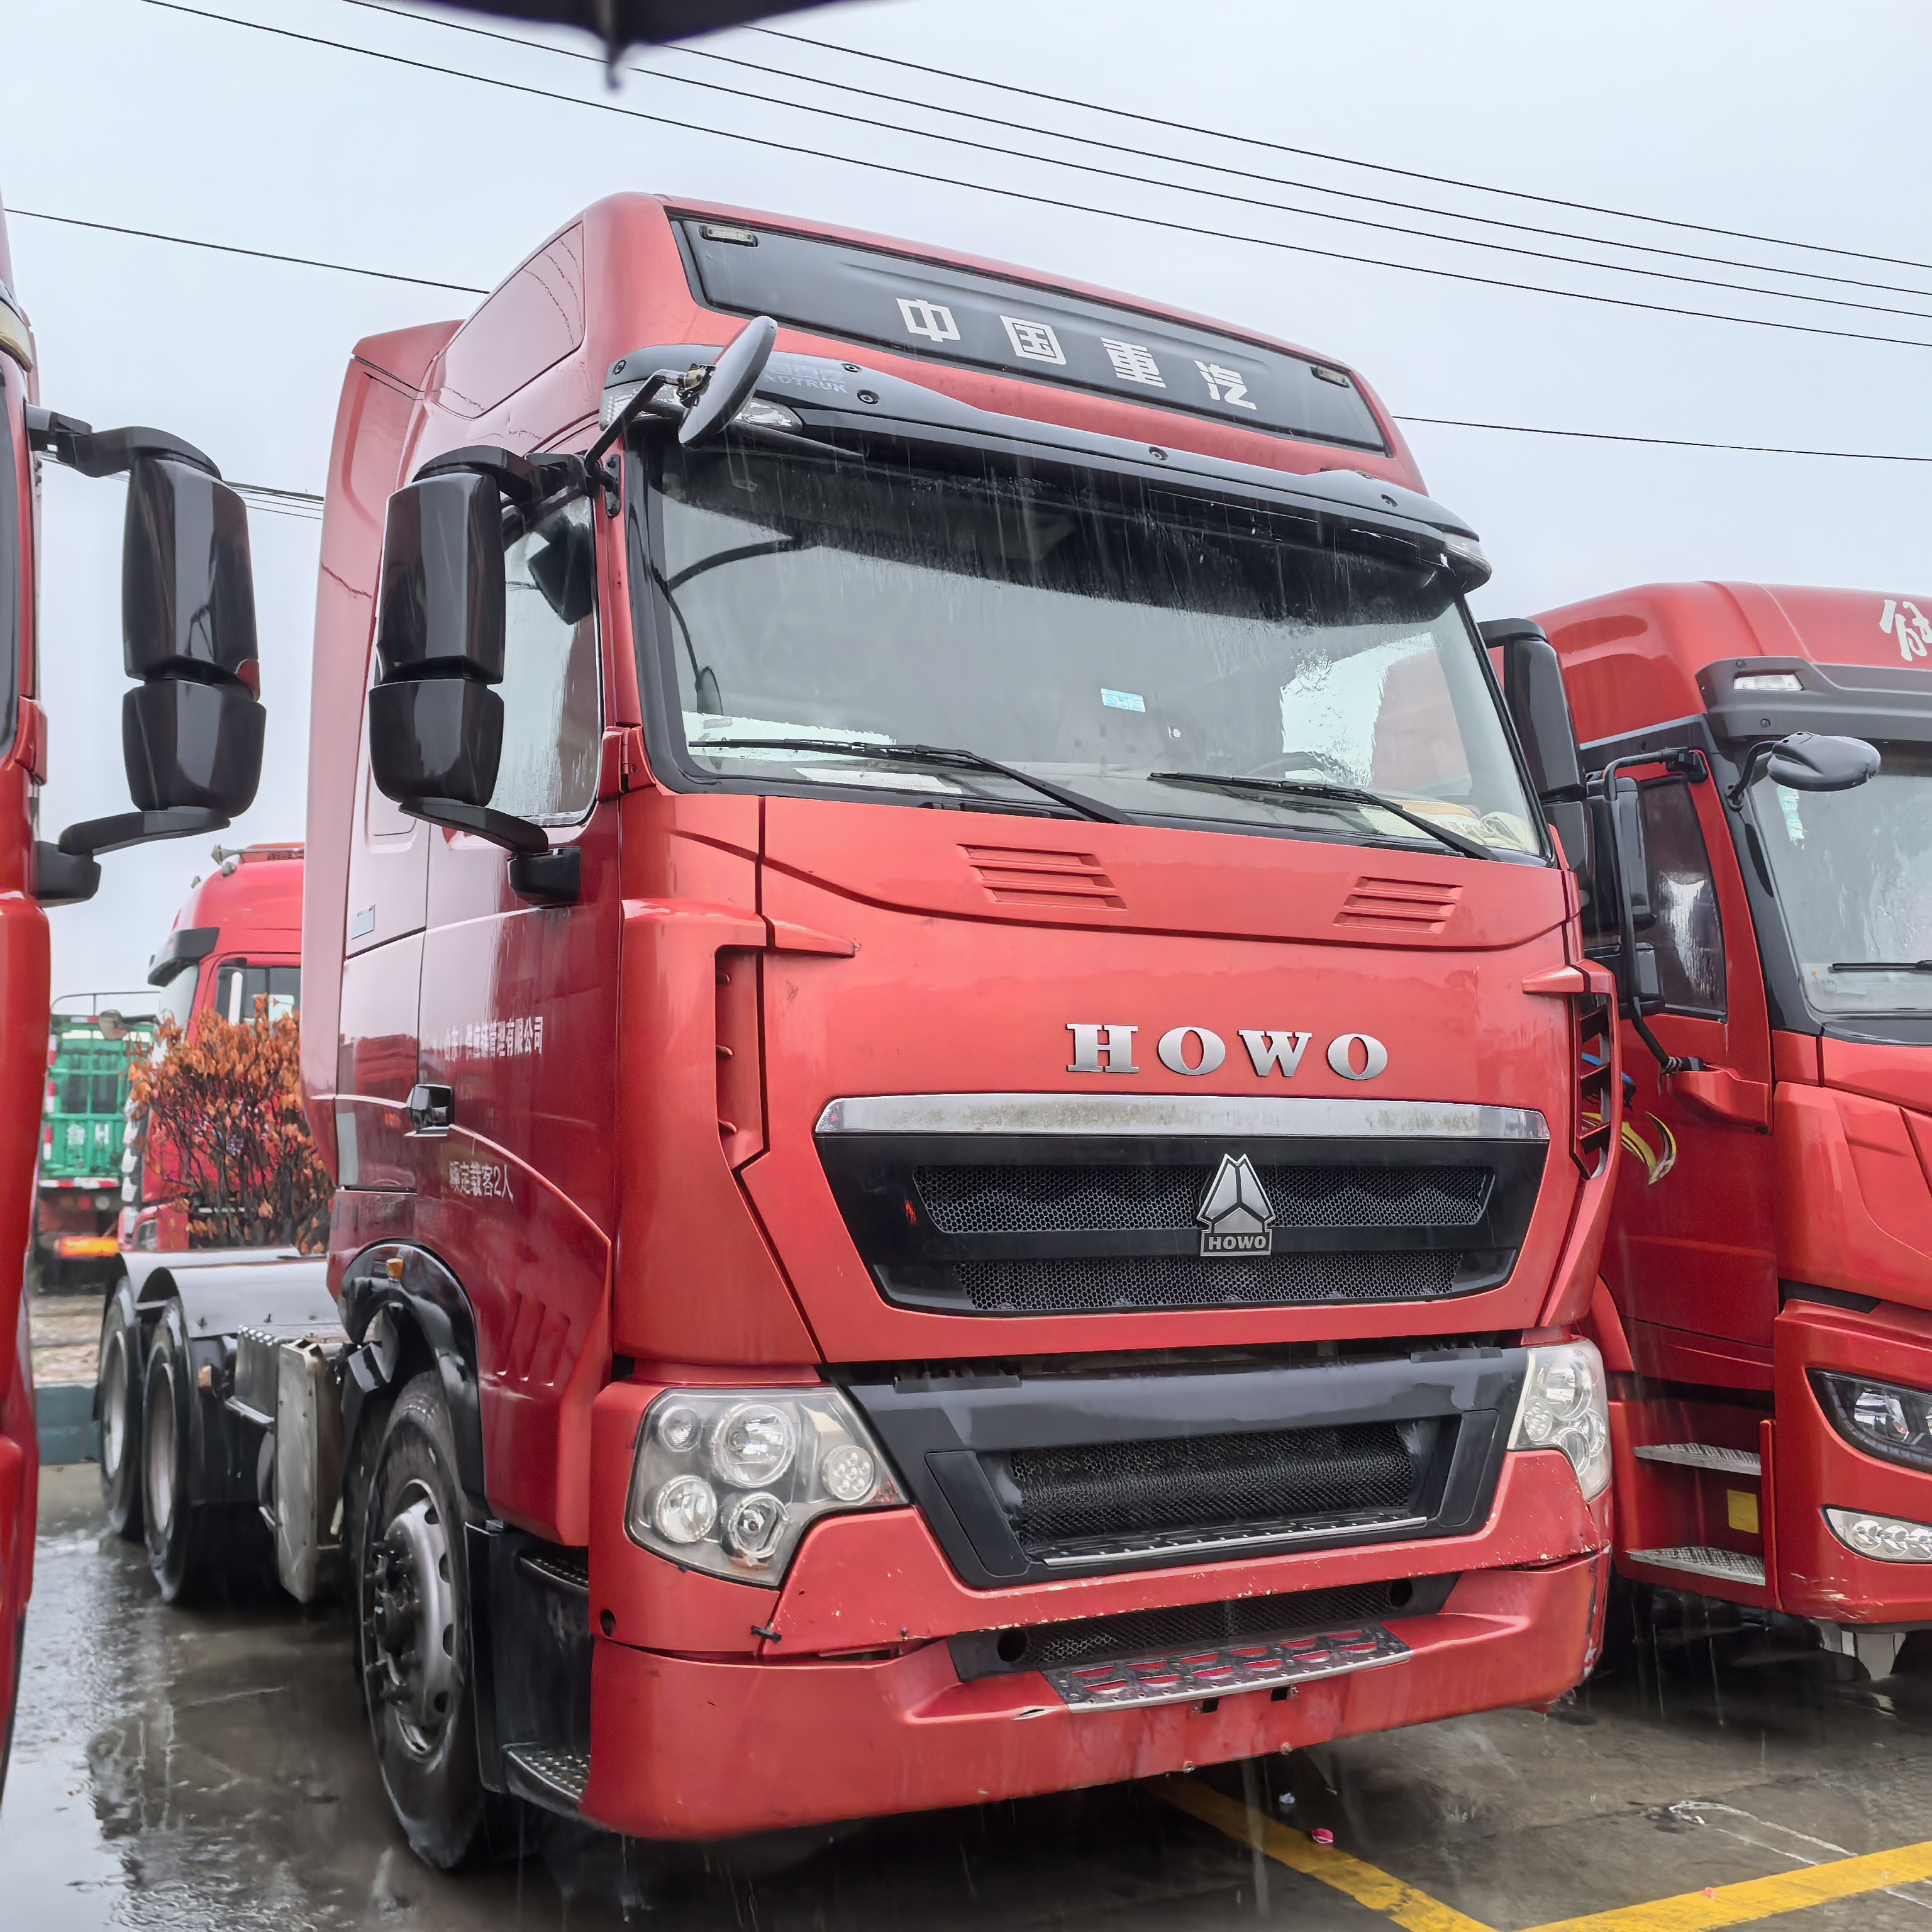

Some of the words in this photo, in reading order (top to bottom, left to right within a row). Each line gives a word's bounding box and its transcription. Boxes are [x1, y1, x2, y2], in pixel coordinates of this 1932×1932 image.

[896, 297, 1257, 410] 中国重汽
[763, 374, 848, 394] NOTRUK
[1066, 1023, 1389, 1080] HOWO
[1208, 1235, 1267, 1250] HOWO
